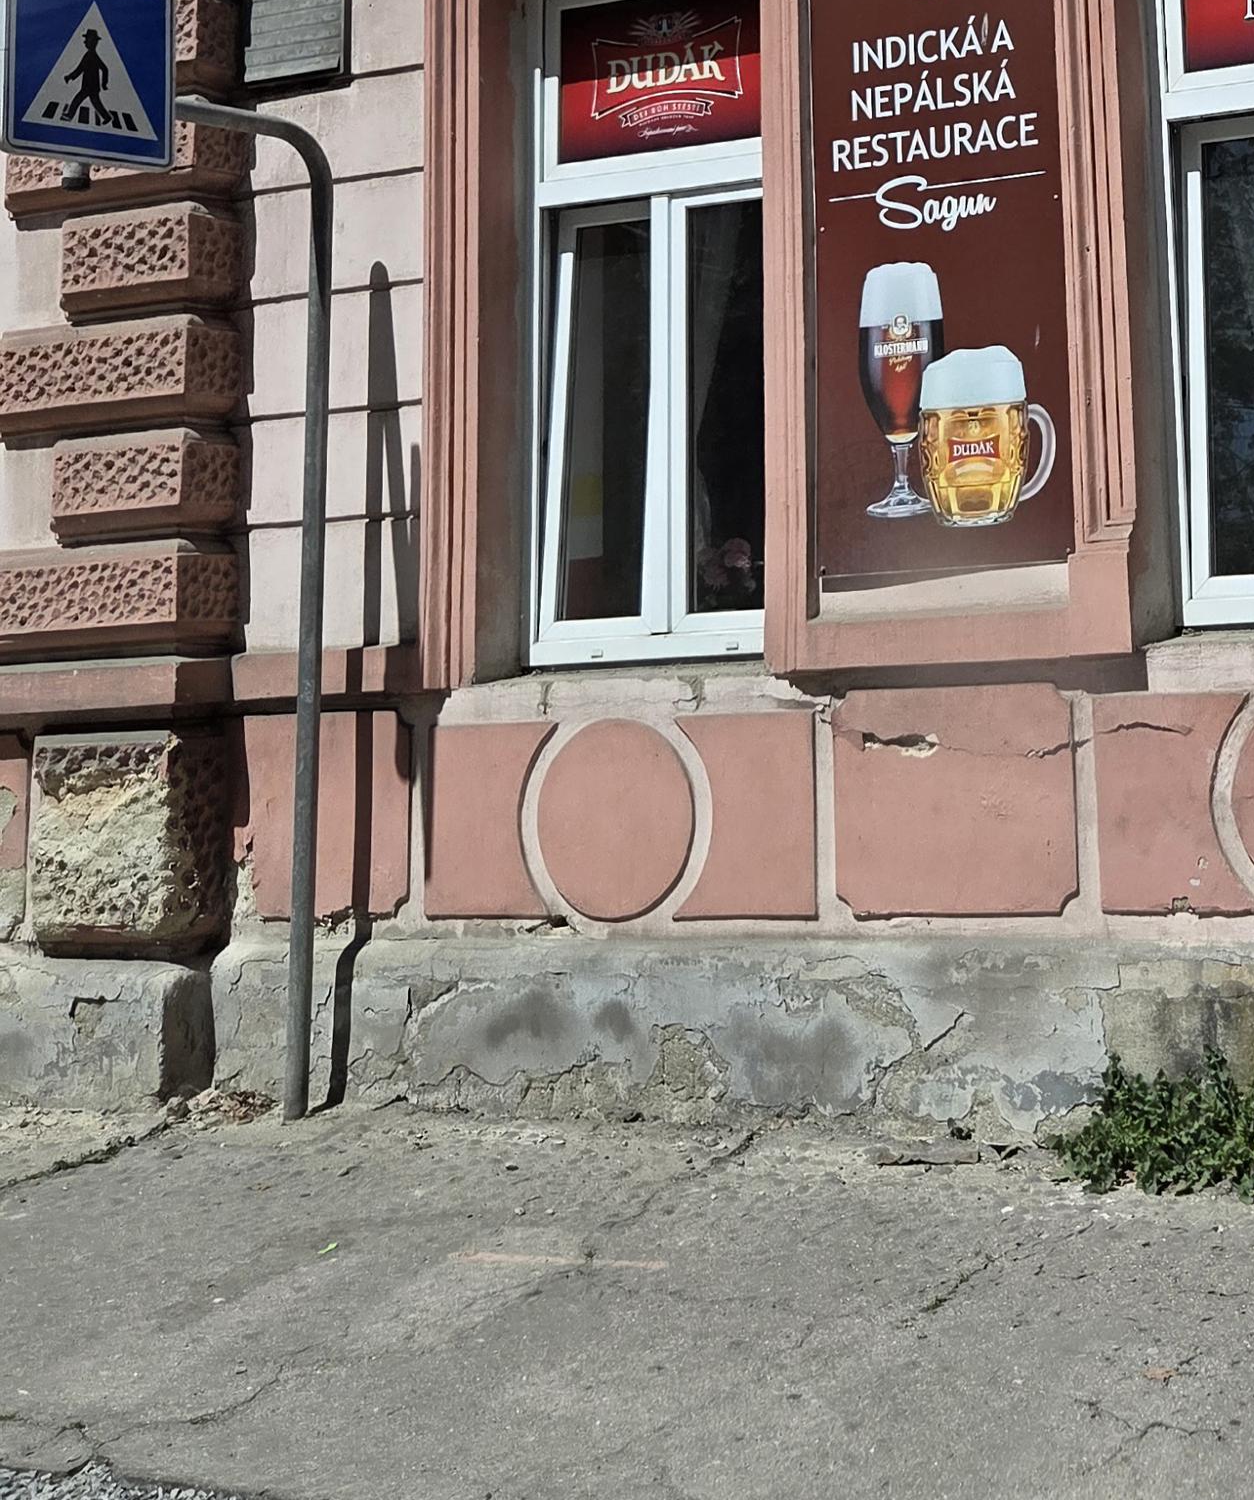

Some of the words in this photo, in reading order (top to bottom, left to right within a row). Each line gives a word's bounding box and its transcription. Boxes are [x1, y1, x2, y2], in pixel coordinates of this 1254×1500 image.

[606, 41, 726, 94] DUDÁK
[852, 15, 984, 74] INDICKÁ
[990, 19, 1015, 53] A
[851, 59, 1016, 122] NEPÁLSKÁ
[832, 112, 1039, 172] RESTAURACE
[875, 175, 997, 231] Sagun
